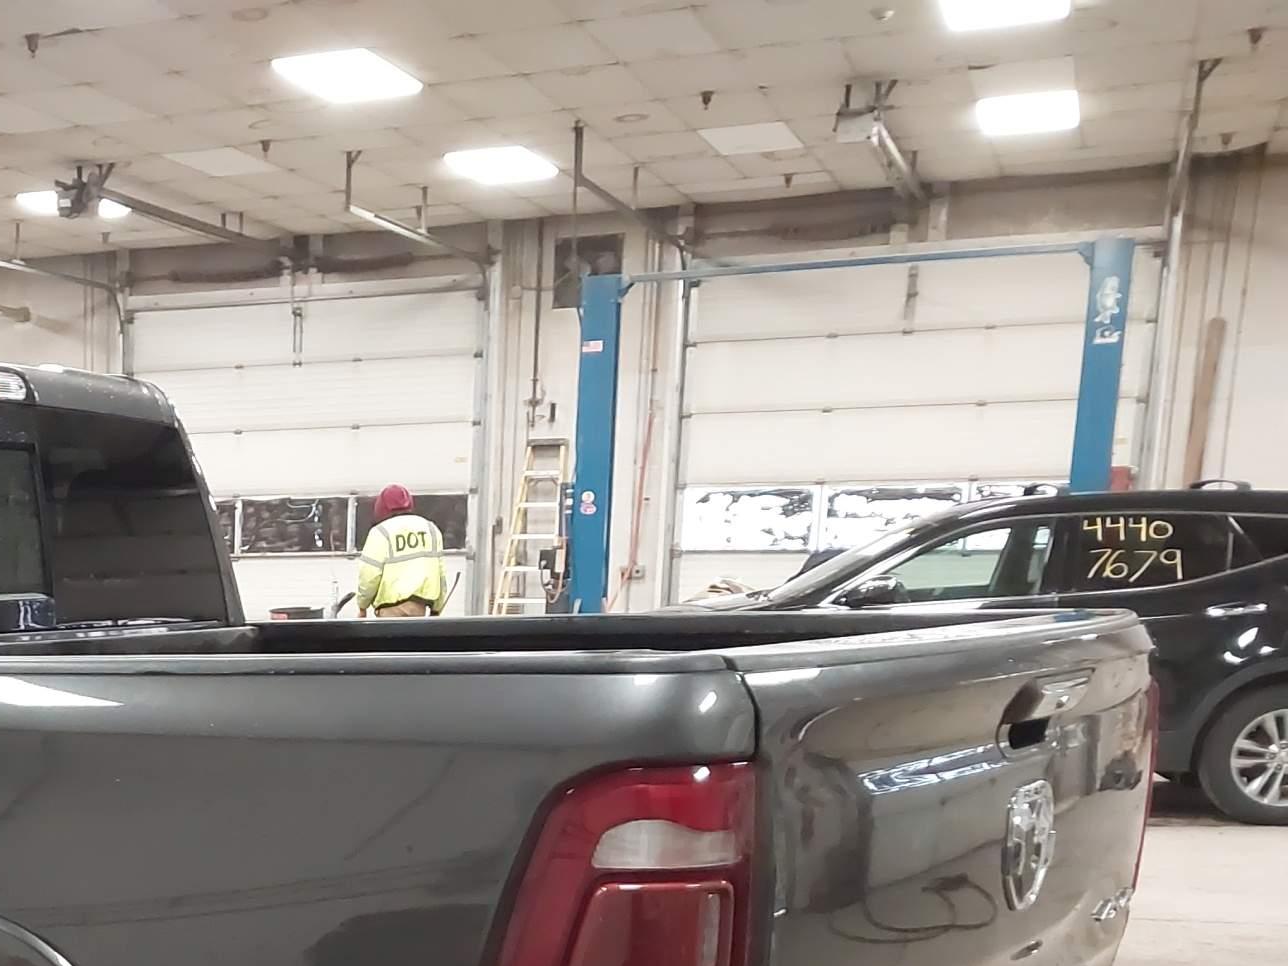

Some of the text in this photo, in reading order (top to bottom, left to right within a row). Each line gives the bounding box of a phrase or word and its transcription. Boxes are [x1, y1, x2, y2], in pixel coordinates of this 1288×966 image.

[395, 531, 427, 553] DOT
[1082, 516, 1174, 542] 4440
[1087, 548, 1183, 583] 7679
